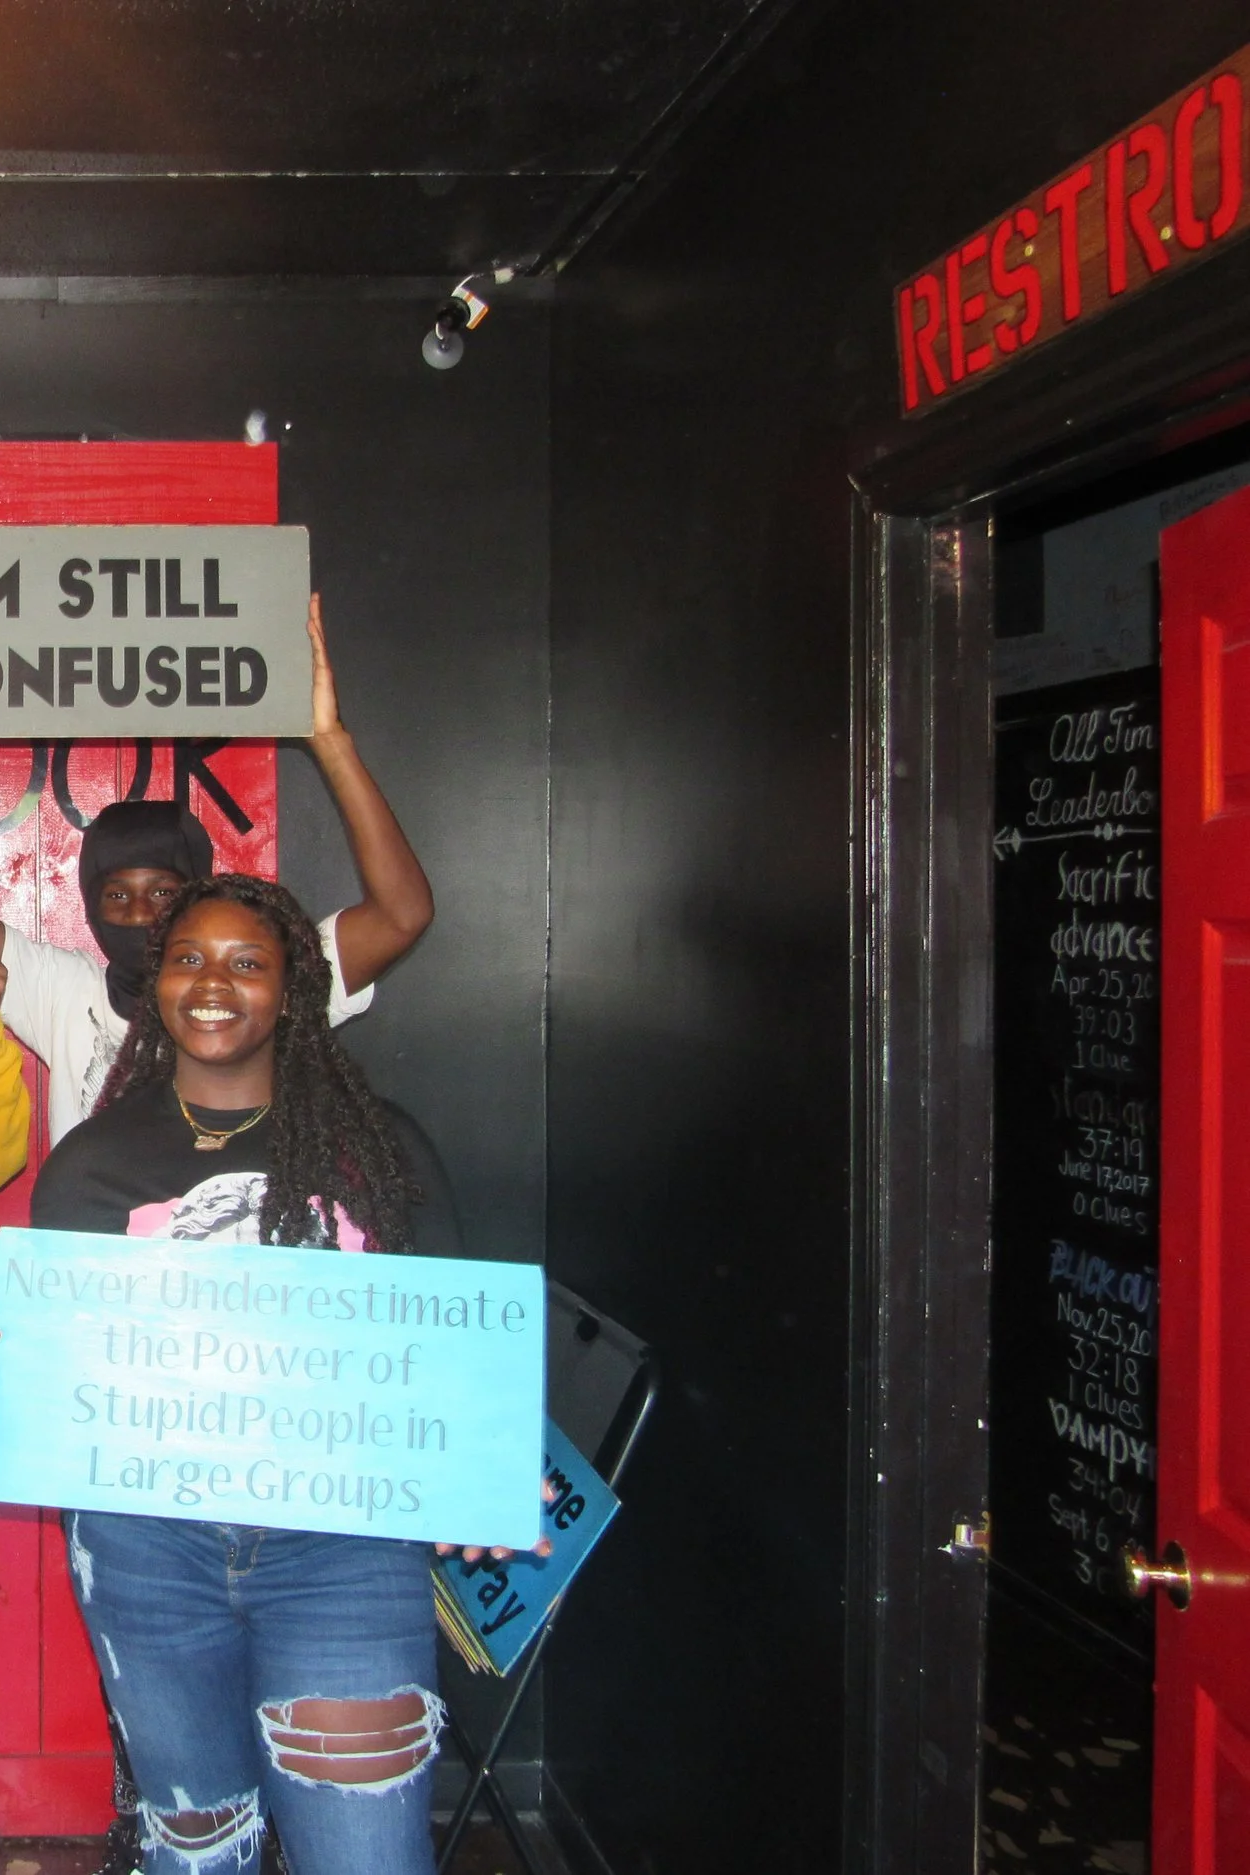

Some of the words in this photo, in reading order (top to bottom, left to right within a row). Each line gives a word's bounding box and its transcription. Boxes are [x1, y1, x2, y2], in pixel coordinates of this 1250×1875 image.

[899, 72, 1244, 412] RESTRO
[57, 557, 239, 619] STILL
[1050, 707, 1100, 763] All
[1071, 1003, 1135, 1046] 39:03
[1058, 1149, 1092, 1182] June
[1077, 1126, 1144, 1172] 37:19
[1090, 1196, 1149, 1236] Clues
[6, 1256, 148, 1304] Never
[159, 1266, 527, 1335] Underestimate
[102, 1322, 180, 1370] the
[192, 1331, 353, 1381] Power
[366, 1343, 422, 1387] of
[1067, 1333, 1140, 1397] 32:18
[71, 1382, 227, 1442] Stupid
[237, 1395, 394, 1455] People
[406, 1406, 447, 1452] in
[1084, 1381, 1143, 1431] Clues
[88, 1445, 233, 1506] Large
[245, 1458, 422, 1523] Groups
[544, 1454, 586, 1531] me
